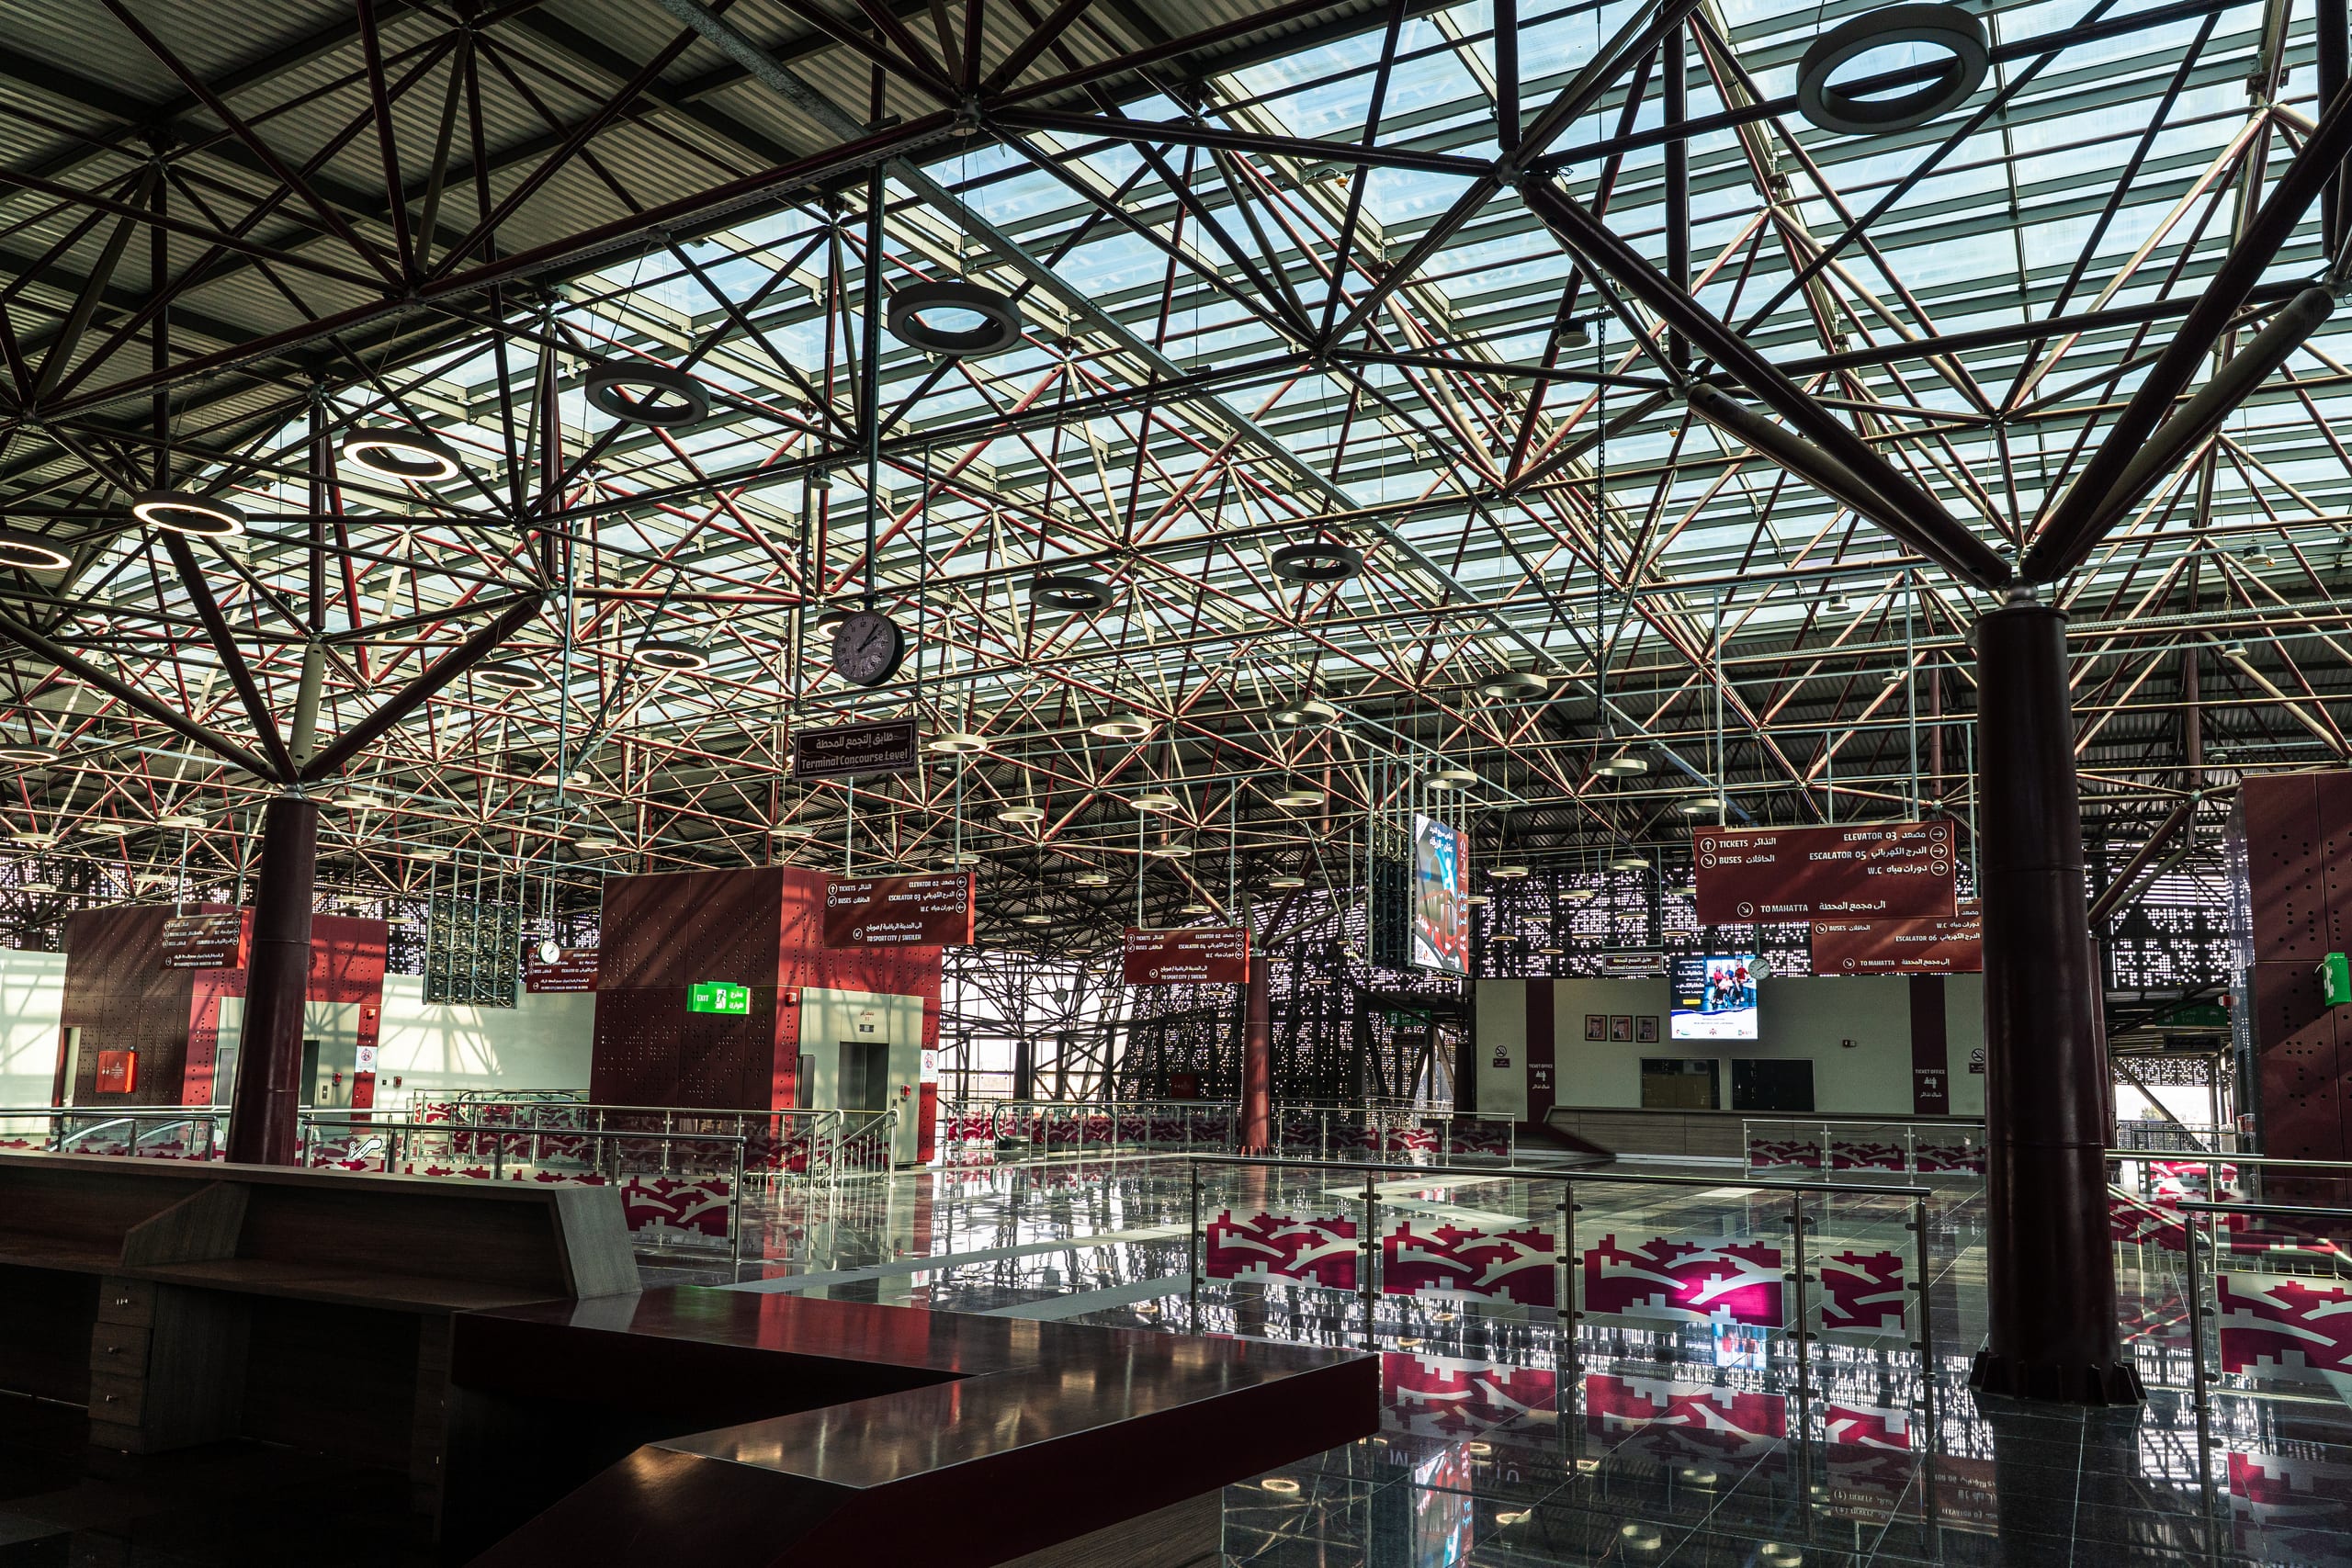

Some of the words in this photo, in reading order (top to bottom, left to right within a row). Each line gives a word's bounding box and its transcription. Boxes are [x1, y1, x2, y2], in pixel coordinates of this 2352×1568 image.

[816, 736, 844, 749] للمحطة
[873, 731, 894, 746] طابق
[801, 755, 839, 770] Terminal
[840, 752, 883, 765] Concourse
[885, 748, 908, 761] Level
[1843, 832, 1883, 841] ELEVATOR
[1885, 831, 1896, 840] 03
[1718, 840, 1748, 848] TICKETS
[1753, 837, 1777, 848] التذاكر
[1809, 852, 1852, 860] ESCALATOR
[1855, 851, 1866, 860] 05
[1905, 846, 1927, 856] الدرج
[1719, 856, 1742, 864] BUSES
[1746, 854, 1775, 863] الحافلات
[1886, 865, 1903, 874] مياه
[1903, 864, 1928, 874] دورات
[1760, 905, 1770, 913] TO
[1771, 904, 1808, 912] MAHATTA
[1819, 901, 1848, 910] المحطة
[1849, 903, 1872, 912] مجمع
